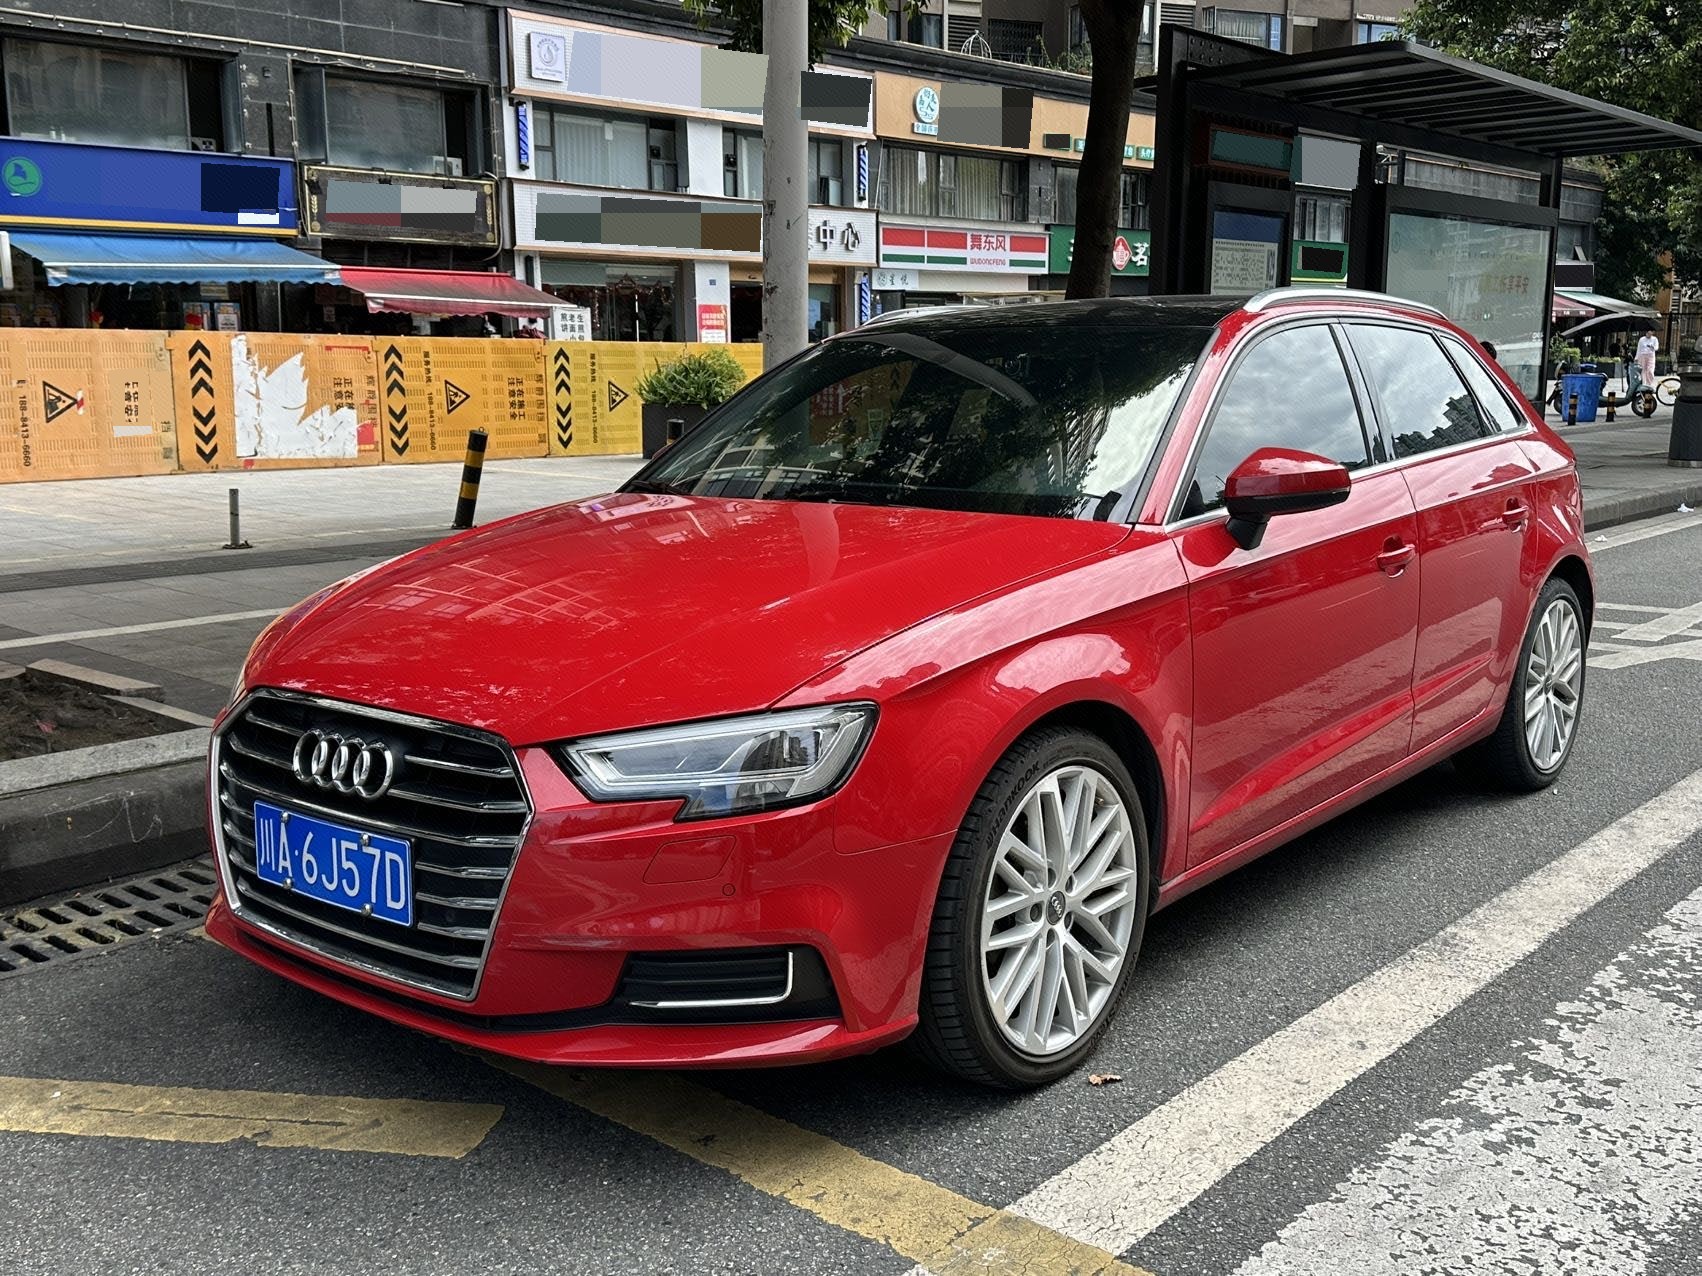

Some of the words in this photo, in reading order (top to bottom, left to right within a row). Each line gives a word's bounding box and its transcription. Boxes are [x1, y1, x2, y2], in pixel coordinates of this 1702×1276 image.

[970, 232, 1006, 251] 舞东风
[427, 392, 437, 450] 188-8413-6660
[507, 377, 517, 420] 注意安全
[515, 377, 526, 420] 正在施工
[18, 395, 31, 467] 188-8413-6660
[260, 818, 406, 910] 川A·6J57D
